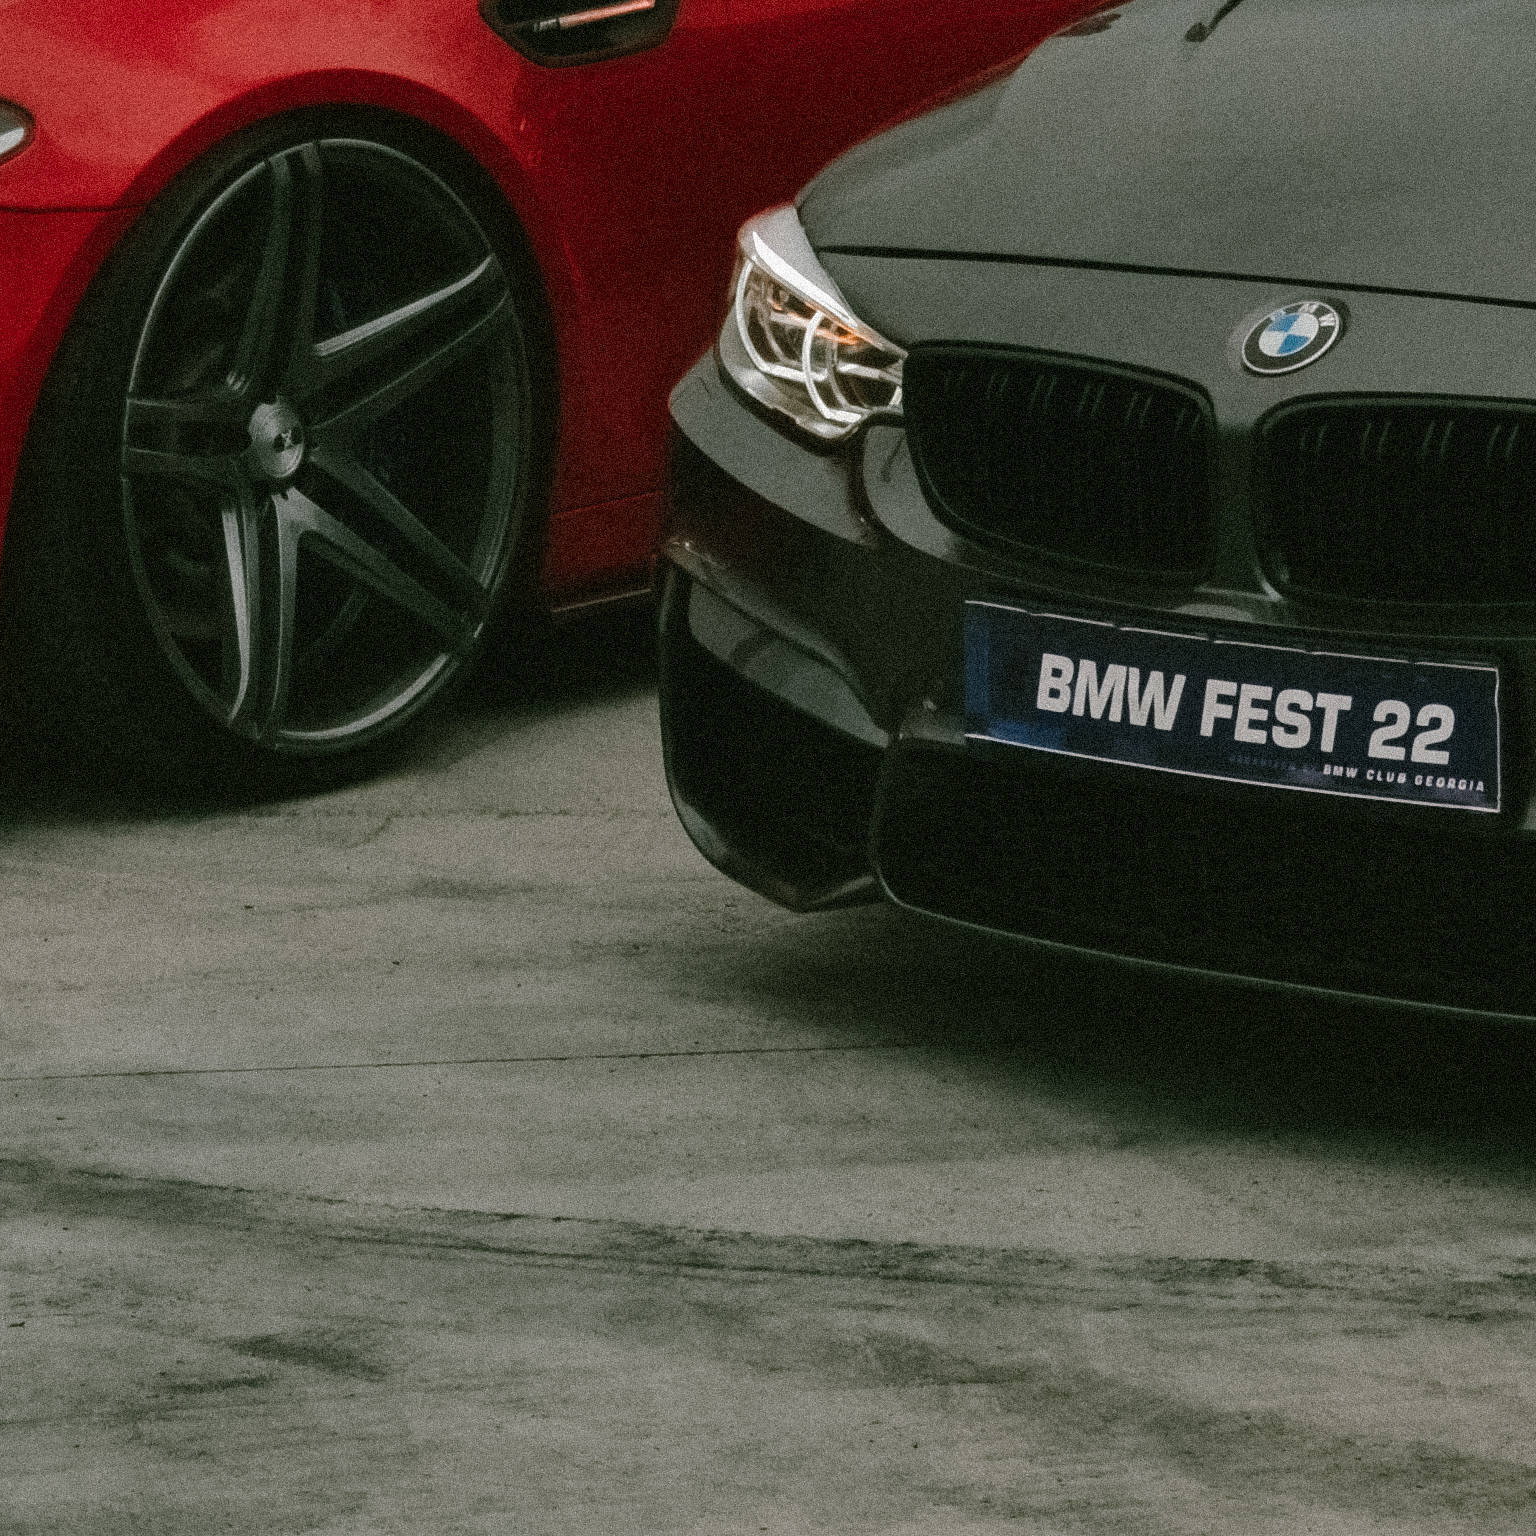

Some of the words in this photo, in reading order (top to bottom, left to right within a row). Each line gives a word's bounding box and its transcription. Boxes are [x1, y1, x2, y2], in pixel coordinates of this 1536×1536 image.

[1036, 652, 1187, 732] BMW
[1200, 677, 1353, 753] FEST
[1367, 698, 1456, 766] 22
[1323, 763, 1359, 778] BMW
[1366, 768, 1408, 784] CLUB
[1414, 774, 1486, 792] GEORGIA
